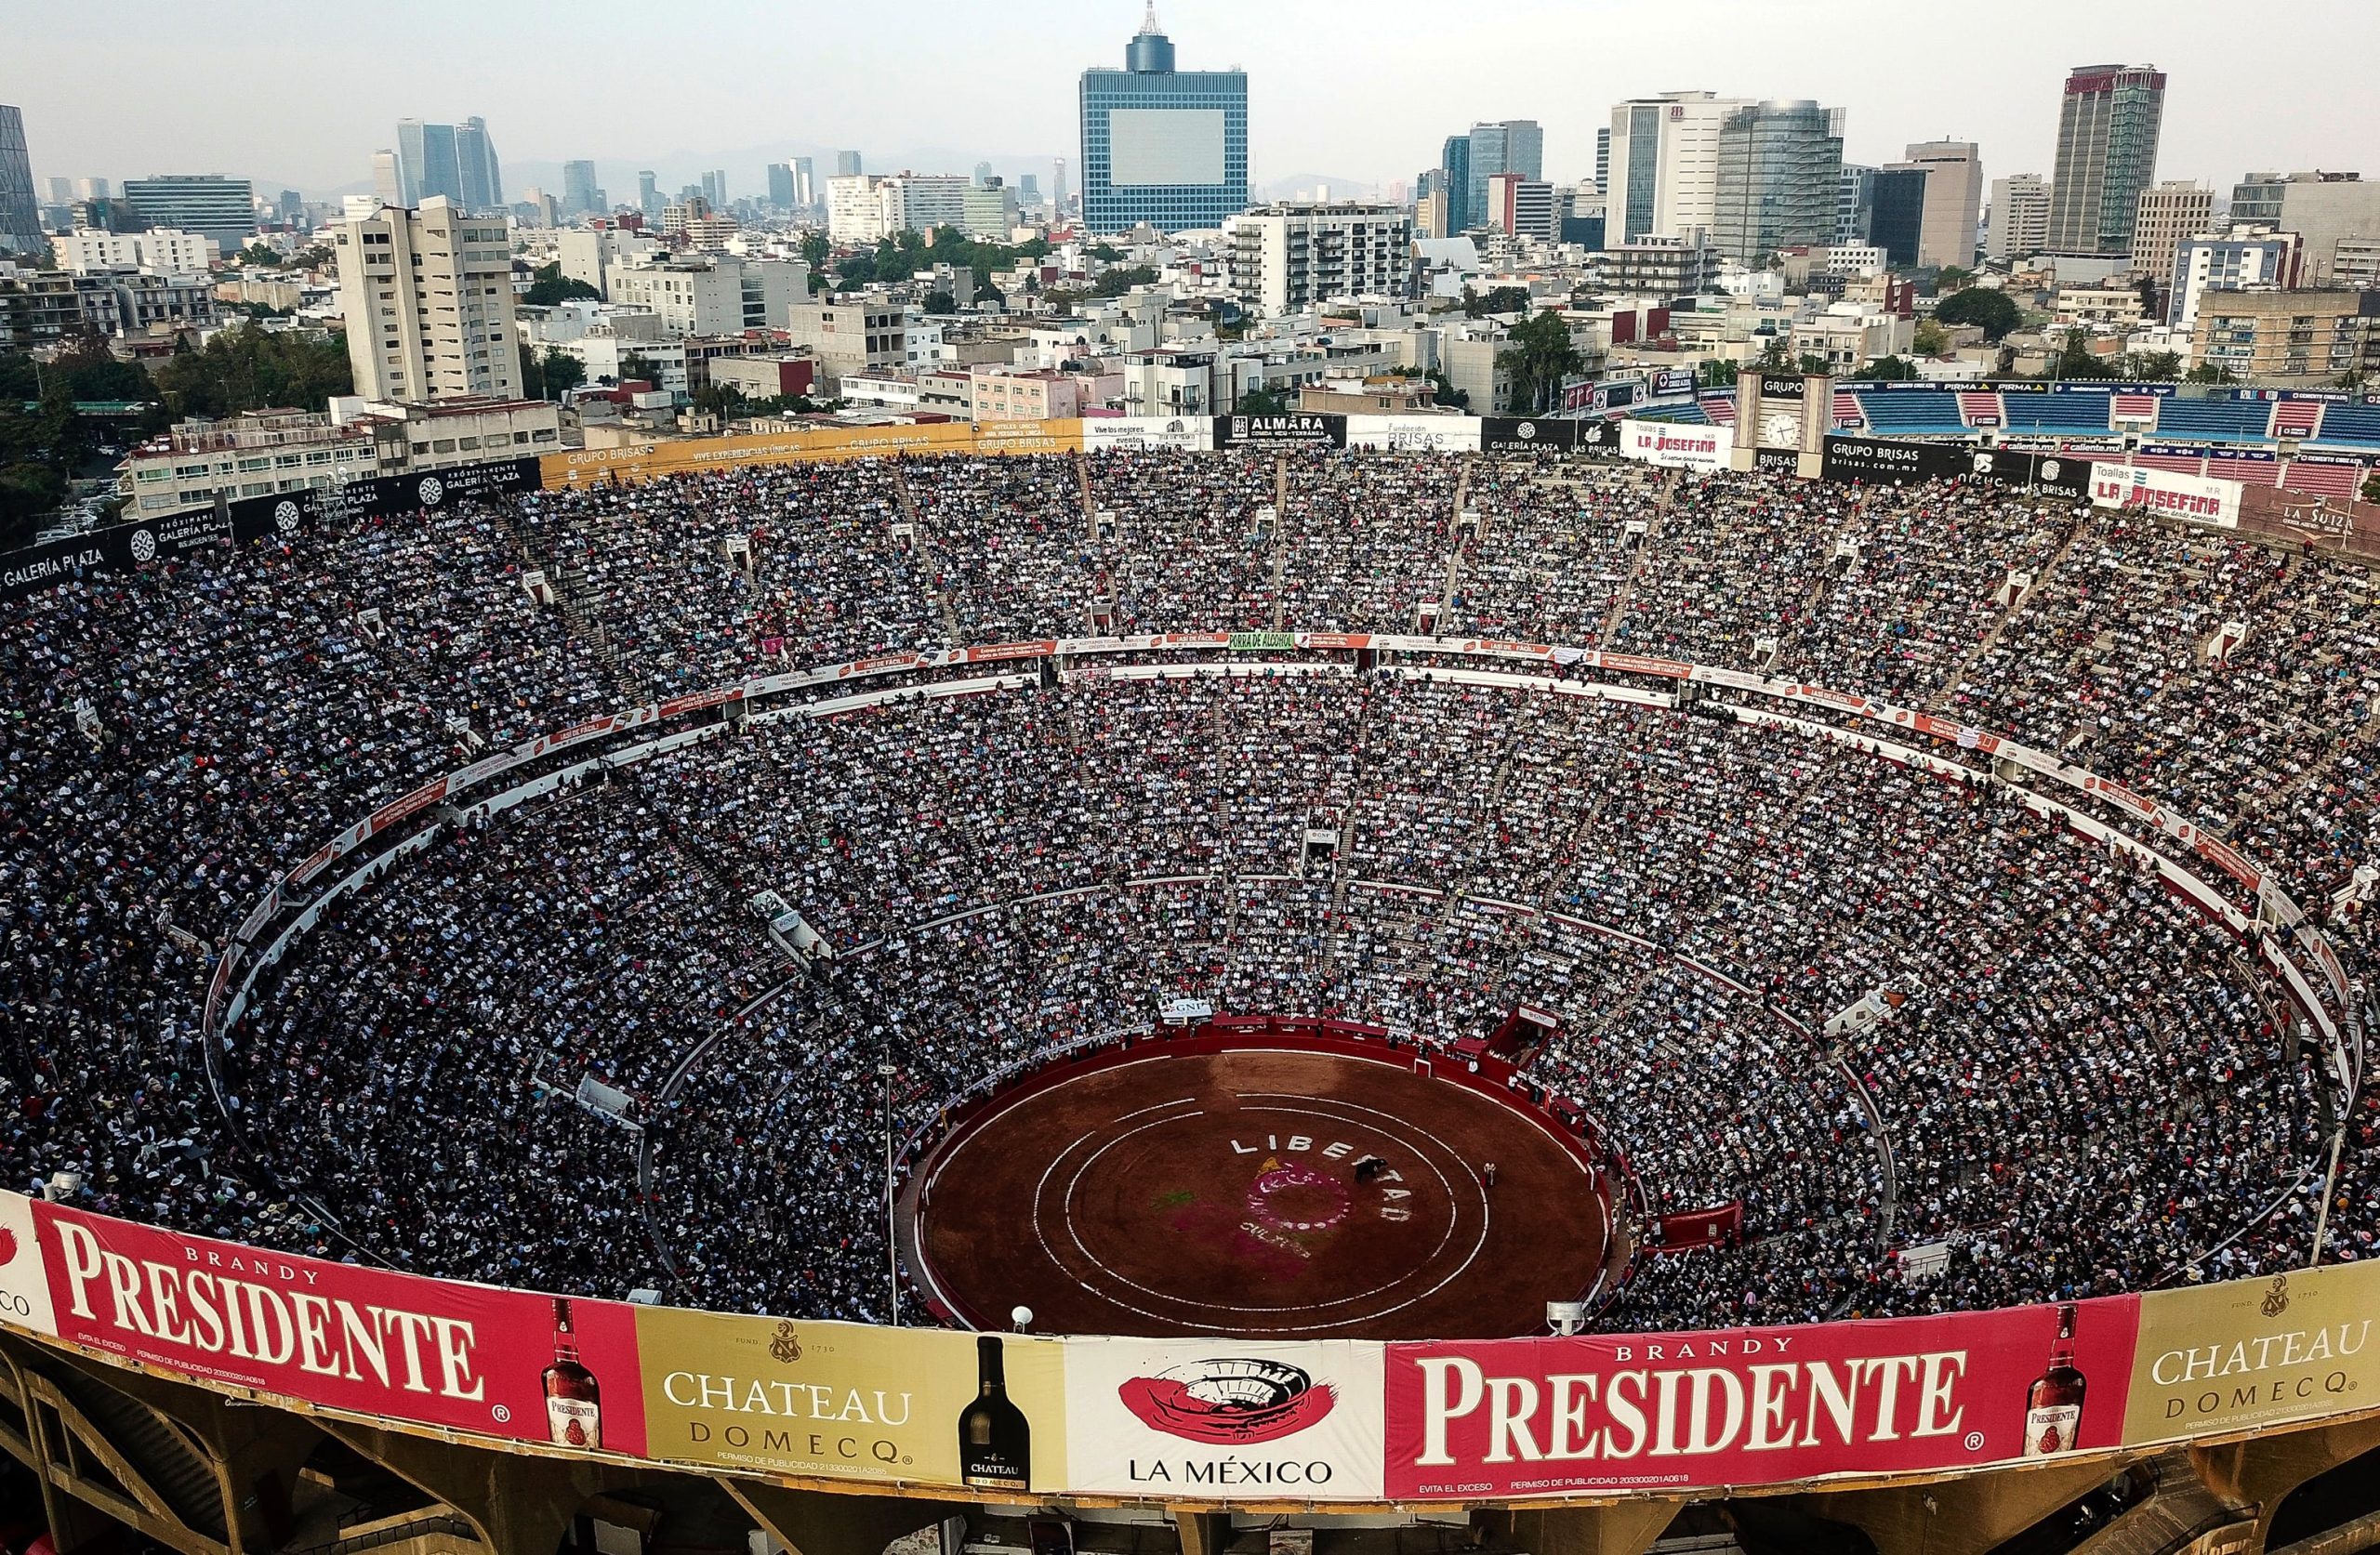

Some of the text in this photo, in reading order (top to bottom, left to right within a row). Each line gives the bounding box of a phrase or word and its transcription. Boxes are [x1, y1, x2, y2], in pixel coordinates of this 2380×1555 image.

[1765, 381, 1805, 392] GRUPO
[1117, 426, 1144, 435] mejores
[1251, 417, 1325, 429] ALMARA
[1388, 423, 1426, 432] Fundación
[850, 436, 929, 451] GRUPO BRISAS
[978, 438, 1056, 451] GRUPO BRISAS
[1491, 441, 1558, 452] GALERÍA PLAZA
[1571, 442, 1619, 455] LAS BRISAS
[1638, 436, 1651, 447] LA
[2007, 442, 2055, 451] caliente.mx
[2069, 441, 2121, 453] caliente.mx
[568, 446, 648, 465] GRUPO BRISAS
[1832, 442, 1919, 461] GRUPO BRISAS
[1760, 455, 1797, 468] BRISAS
[2096, 466, 2130, 479] Toallas
[446, 475, 488, 490] GALERÍA
[2042, 483, 2078, 497] BRISAS
[2097, 481, 2121, 499] LA
[348, 493, 378, 505] PLAZA
[2283, 507, 2301, 520] LA
[160, 513, 215, 531] PRÓXIMAME
[159, 525, 201, 543] GALERÍA
[4, 548, 104, 587] GALERÍA PLAZA
[1229, 633, 1291, 648] PORRA DE ALCOHOL
[185, 1245, 320, 1286] BRANDY
[52, 1219, 484, 1402] PRESIDENTE
[77, 1332, 94, 1343] EVITA
[101, 1340, 126, 1352] EXCESO
[137, 1349, 164, 1364] PERMISO
[164, 1357, 174, 1366] DE
[174, 1359, 213, 1375] PUBLICIDAD
[1615, 1338, 1793, 1362] BRANDY
[2151, 1320, 2373, 1387] CHATEAU
[663, 1371, 912, 1426] CHATEAU
[2165, 1371, 2347, 1418] DOMECQ
[551, 1400, 595, 1417] PRESIDENTE
[1414, 1350, 1968, 1466] PRESIDENTE
[2031, 1410, 2076, 1424] PRESIDENTE
[2185, 1408, 2276, 1430] PERMISO DE PUBLICIDAD
[690, 1421, 898, 1464] DOMECQ
[717, 1451, 753, 1463] PERMISO
[754, 1456, 767, 1465] DE
[768, 1457, 818, 1470] PUBLICIDAD
[971, 1463, 1019, 1475] CHATEAU
[1129, 1456, 1333, 1485] LA MÉXICO
[1419, 1484, 1443, 1493] EVITA
[1445, 1484, 1455, 1493] EL
[1458, 1483, 1492, 1492] EXCESO
[1511, 1480, 1549, 1489] PERMISO
[1551, 1479, 1563, 1487] DE
[1565, 1476, 1618, 1485] PUBLICIDAD
